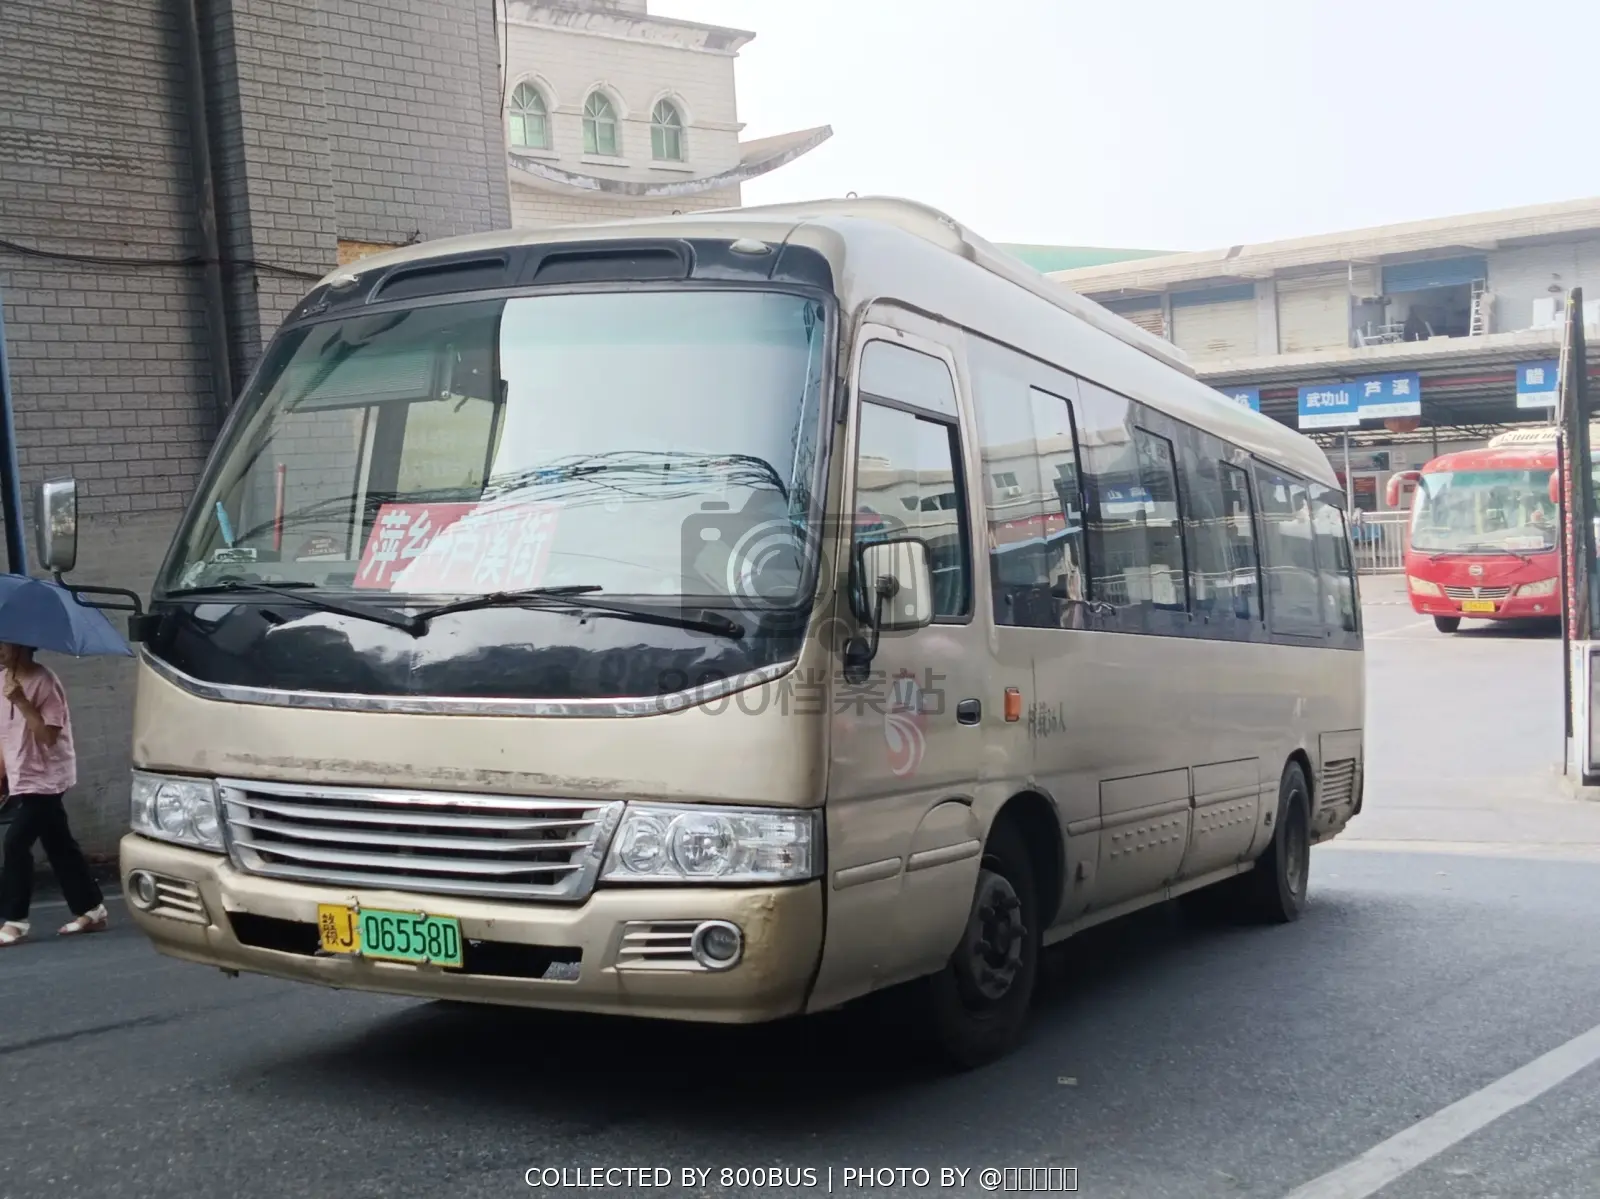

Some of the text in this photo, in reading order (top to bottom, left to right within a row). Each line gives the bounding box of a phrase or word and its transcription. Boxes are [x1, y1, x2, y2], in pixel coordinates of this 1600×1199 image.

[1364, 379, 1410, 397] 芦溪
[1306, 391, 1349, 407] 武功山
